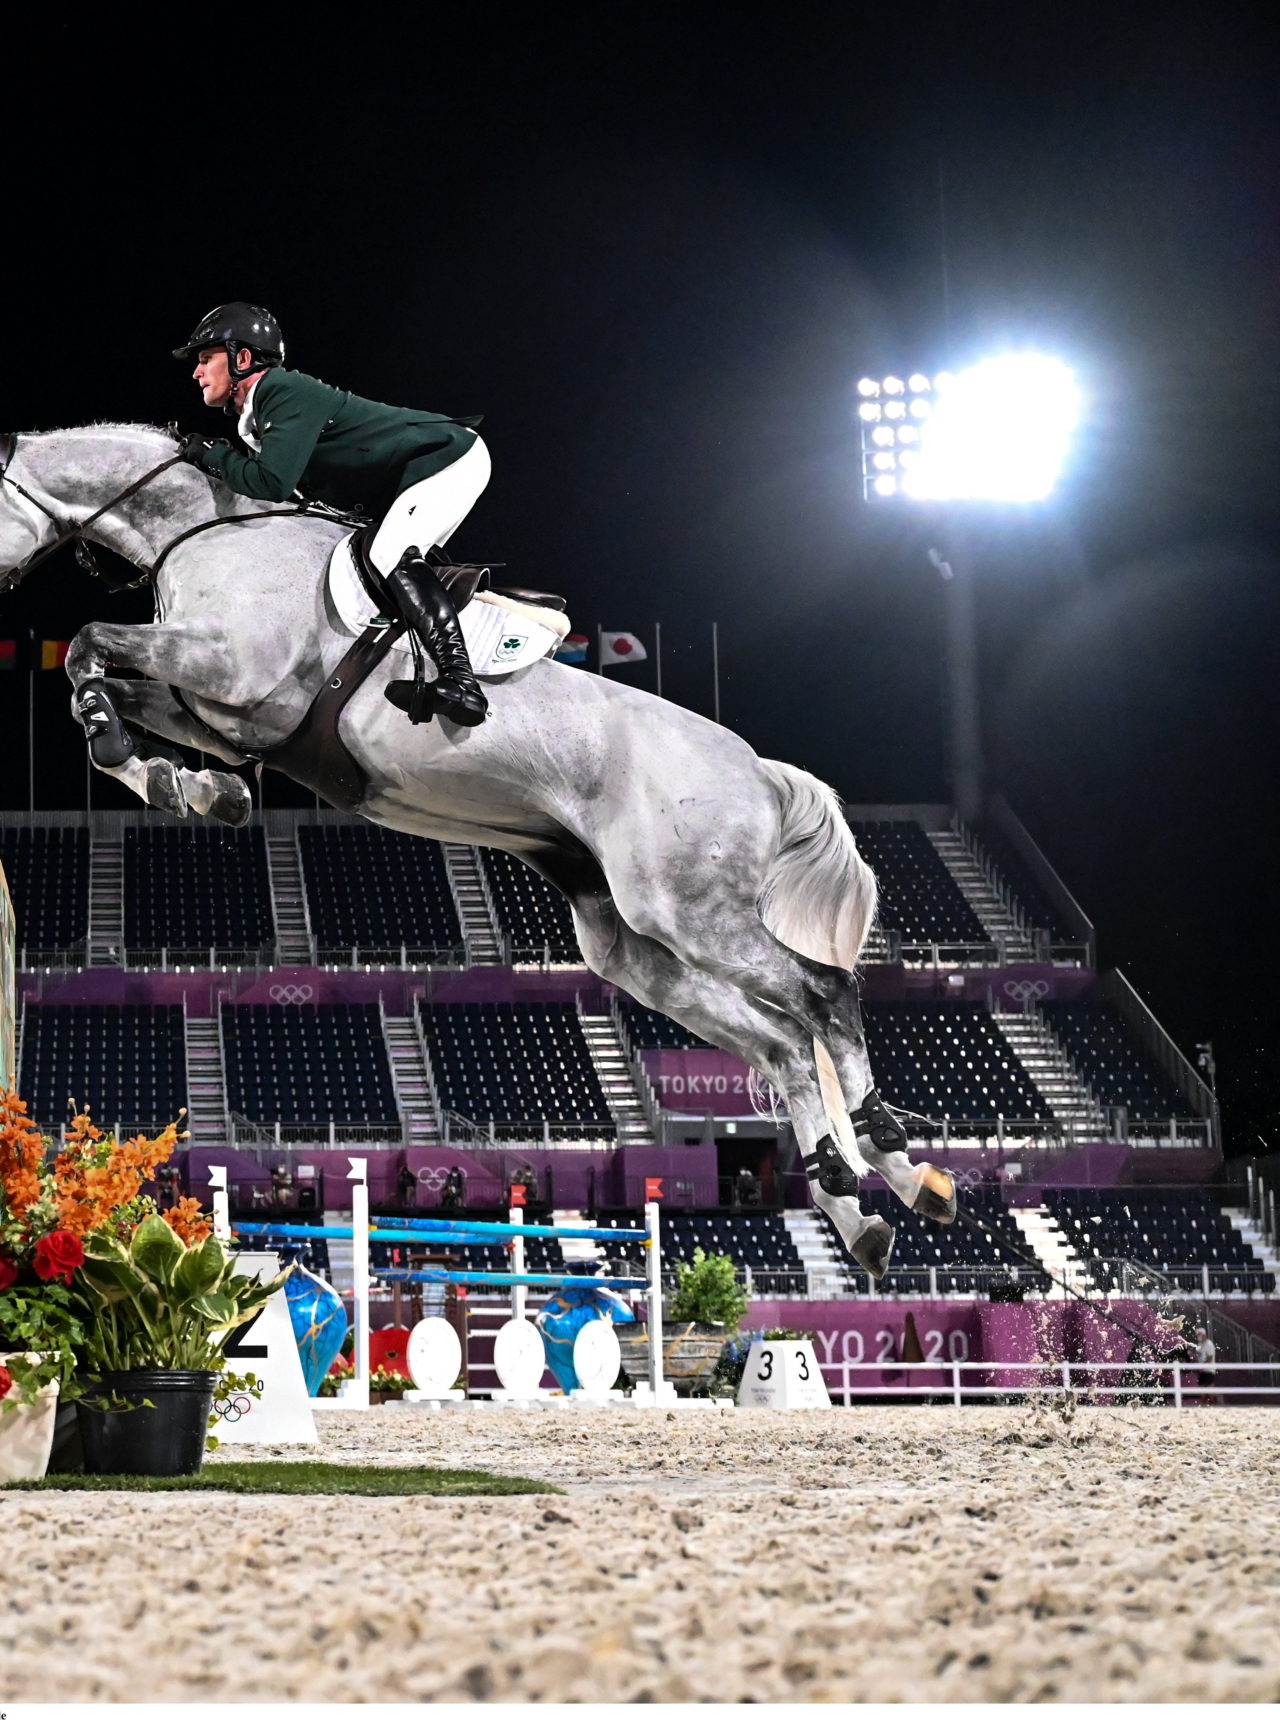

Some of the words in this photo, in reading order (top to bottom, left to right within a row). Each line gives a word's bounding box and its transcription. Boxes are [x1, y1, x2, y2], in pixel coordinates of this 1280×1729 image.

[659, 1075, 728, 1095] TOKYO
[732, 1075, 770, 1095] 202
[875, 1330, 969, 1364] 220
[757, 1350, 774, 1381] 3
[795, 1350, 810, 1381] 3
